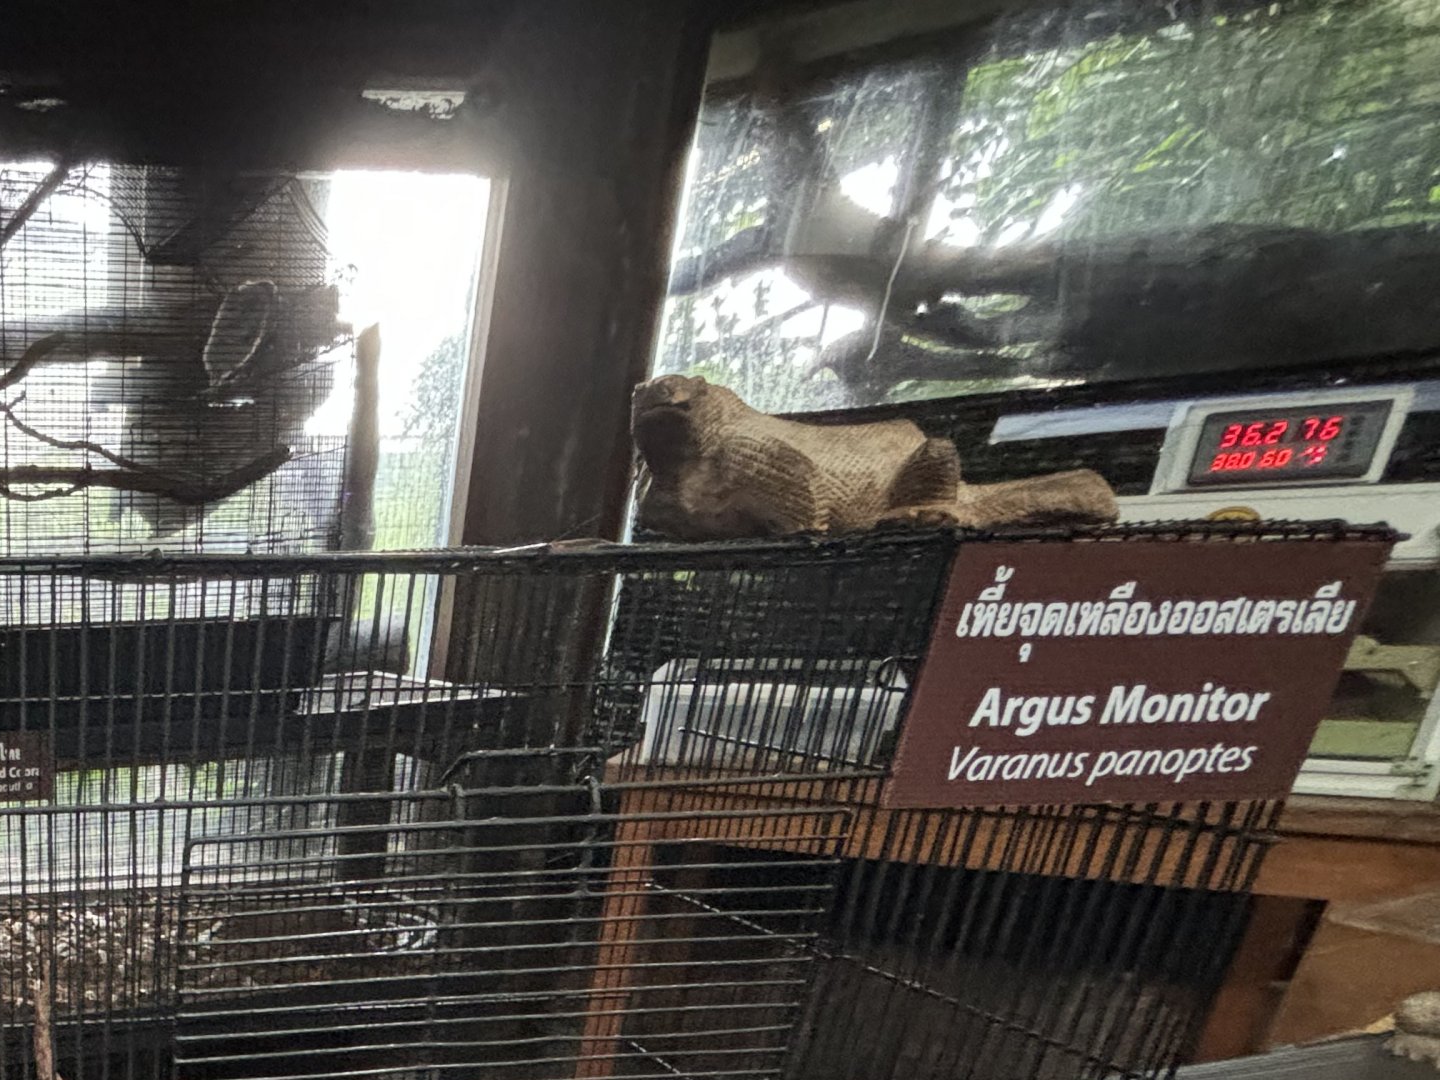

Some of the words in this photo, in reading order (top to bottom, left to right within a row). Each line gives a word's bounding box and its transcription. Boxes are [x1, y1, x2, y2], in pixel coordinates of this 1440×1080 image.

[1303, 416, 1343, 442] 76
[967, 687, 1096, 737] Argus
[1099, 682, 1271, 725] Monitor
[947, 746, 1090, 782] Varanus
[1085, 743, 1258, 786] panoptes
